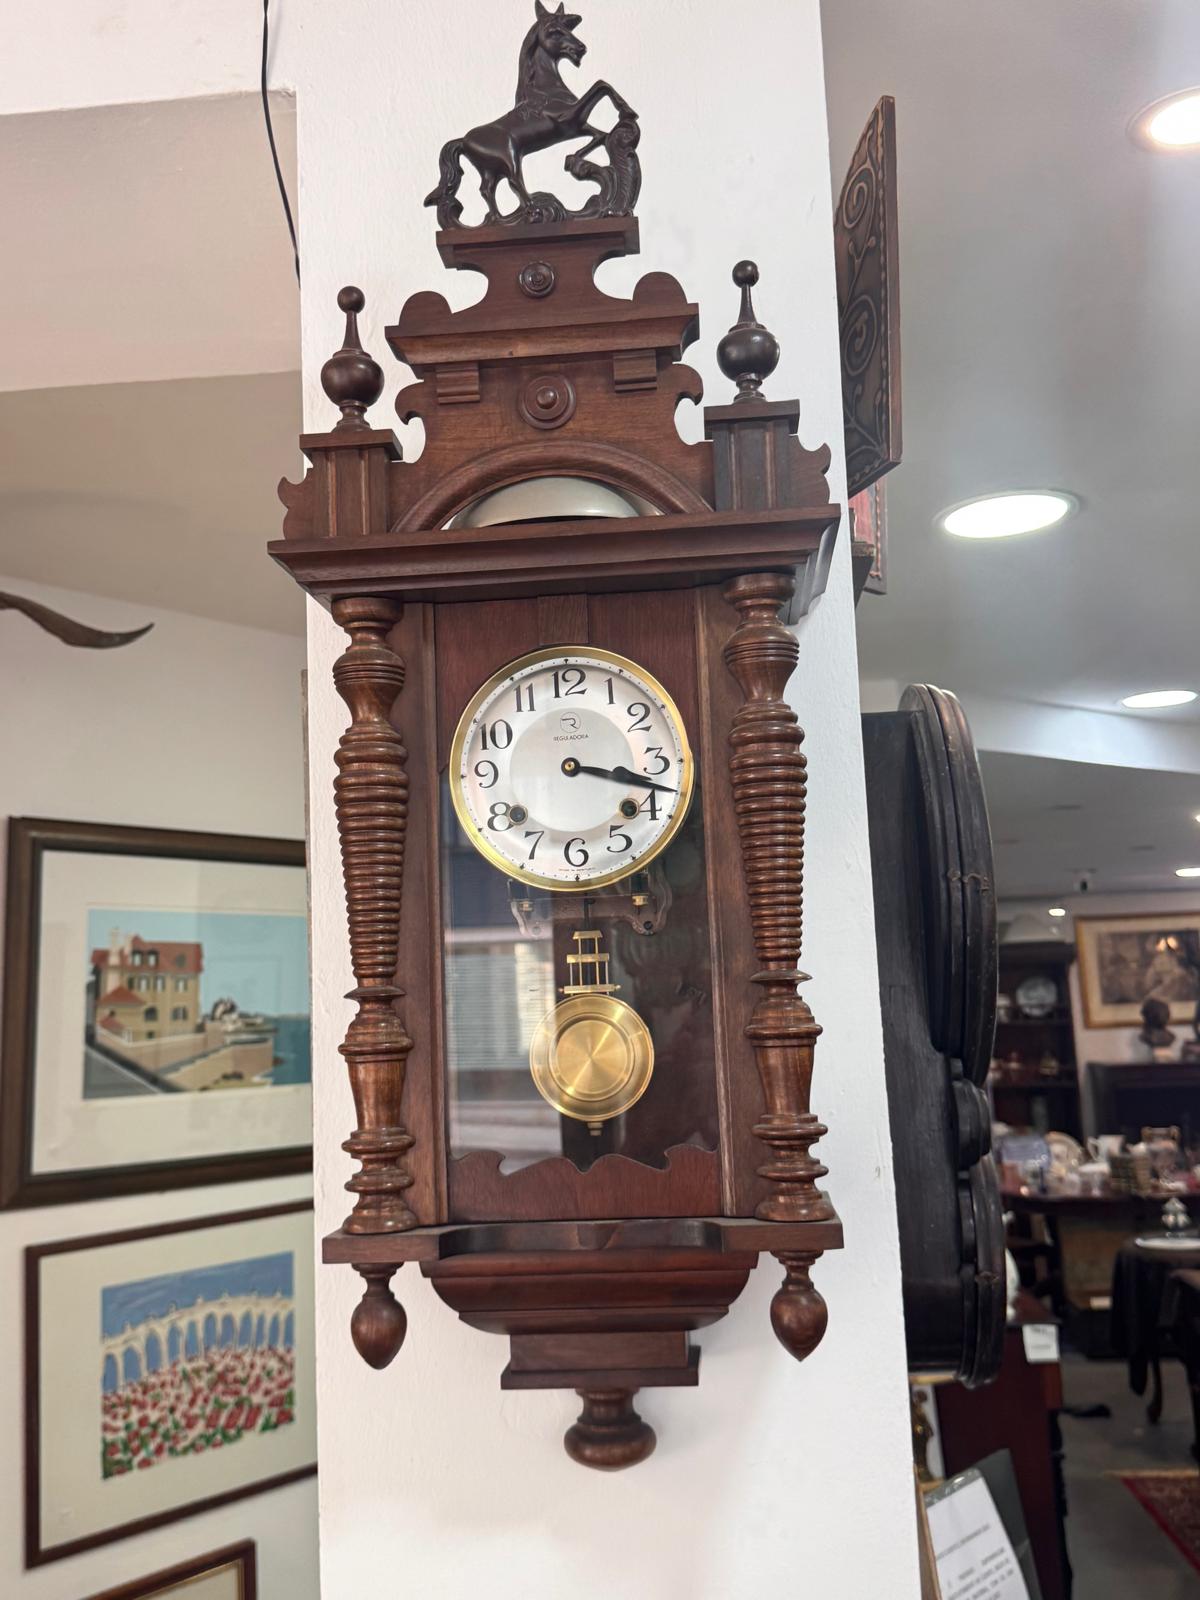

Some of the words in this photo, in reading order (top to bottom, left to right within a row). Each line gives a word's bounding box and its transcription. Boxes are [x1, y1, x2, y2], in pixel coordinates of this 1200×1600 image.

[514, 682, 536, 712] 11
[551, 668, 587, 698] 12
[604, 677, 616, 705] 1
[627, 702, 652, 733] 2
[480, 719, 513, 750] 10
[474, 760, 498, 788] 9
[643, 747, 670, 776] 3
[487, 801, 513, 832] 8
[639, 788, 662, 821] 4
[525, 830, 544, 860] 7
[564, 838, 589, 867] 6
[607, 824, 632, 853] 5
